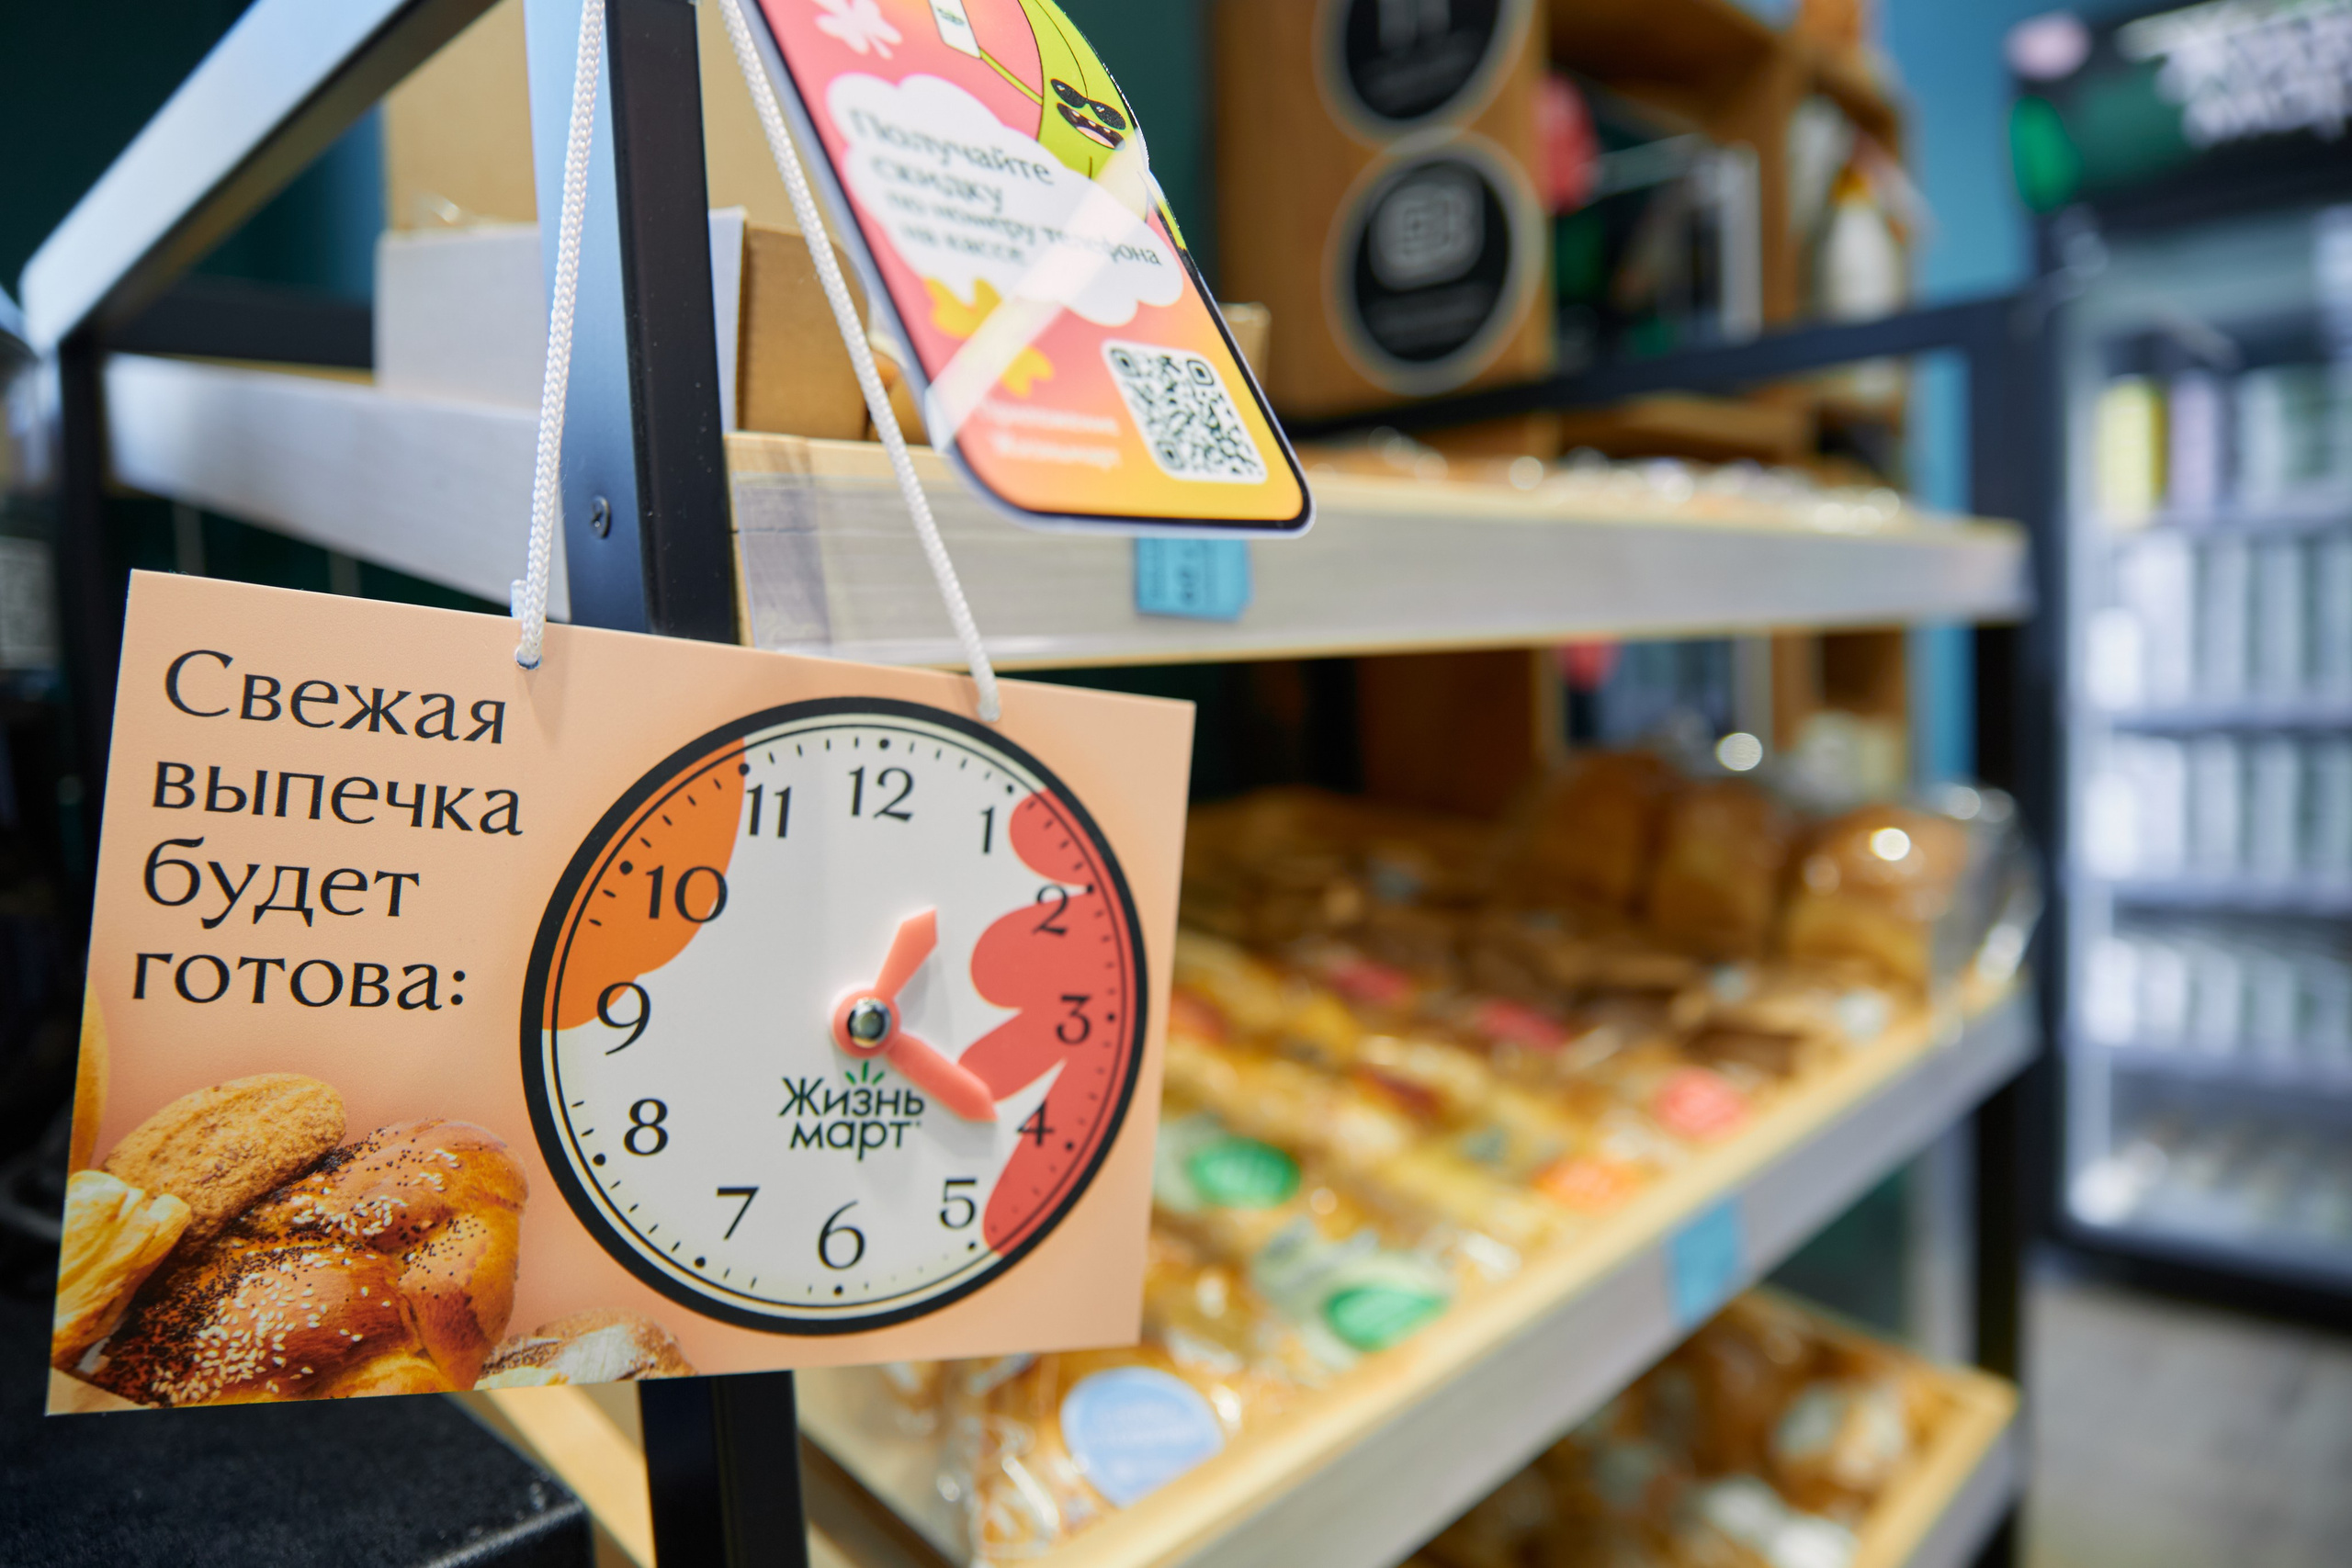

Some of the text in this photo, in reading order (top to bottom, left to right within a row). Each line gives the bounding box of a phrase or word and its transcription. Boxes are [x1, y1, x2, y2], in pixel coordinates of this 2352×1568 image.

[846, 107, 1056, 186] Получайте
[164, 649, 506, 745] Свежая
[152, 761, 524, 837] выпечка
[745, 783, 793, 839] 11
[848, 766, 915, 822] 12
[979, 806, 996, 855] 1
[143, 836, 420, 931] будет
[645, 864, 729, 924] 10
[1033, 885, 1069, 936] 2
[131, 952, 467, 1012] готова:
[596, 981, 651, 1056] 9
[1056, 993, 1092, 1045] 3
[778, 1077, 925, 1118] Жизнь
[1016, 1101, 1055, 1147] 4
[623, 1098, 670, 1156] 8
[789, 1120, 913, 1162] март
[716, 1186, 761, 1241] 7
[939, 1179, 978, 1230] 5
[818, 1201, 865, 1270] 6
